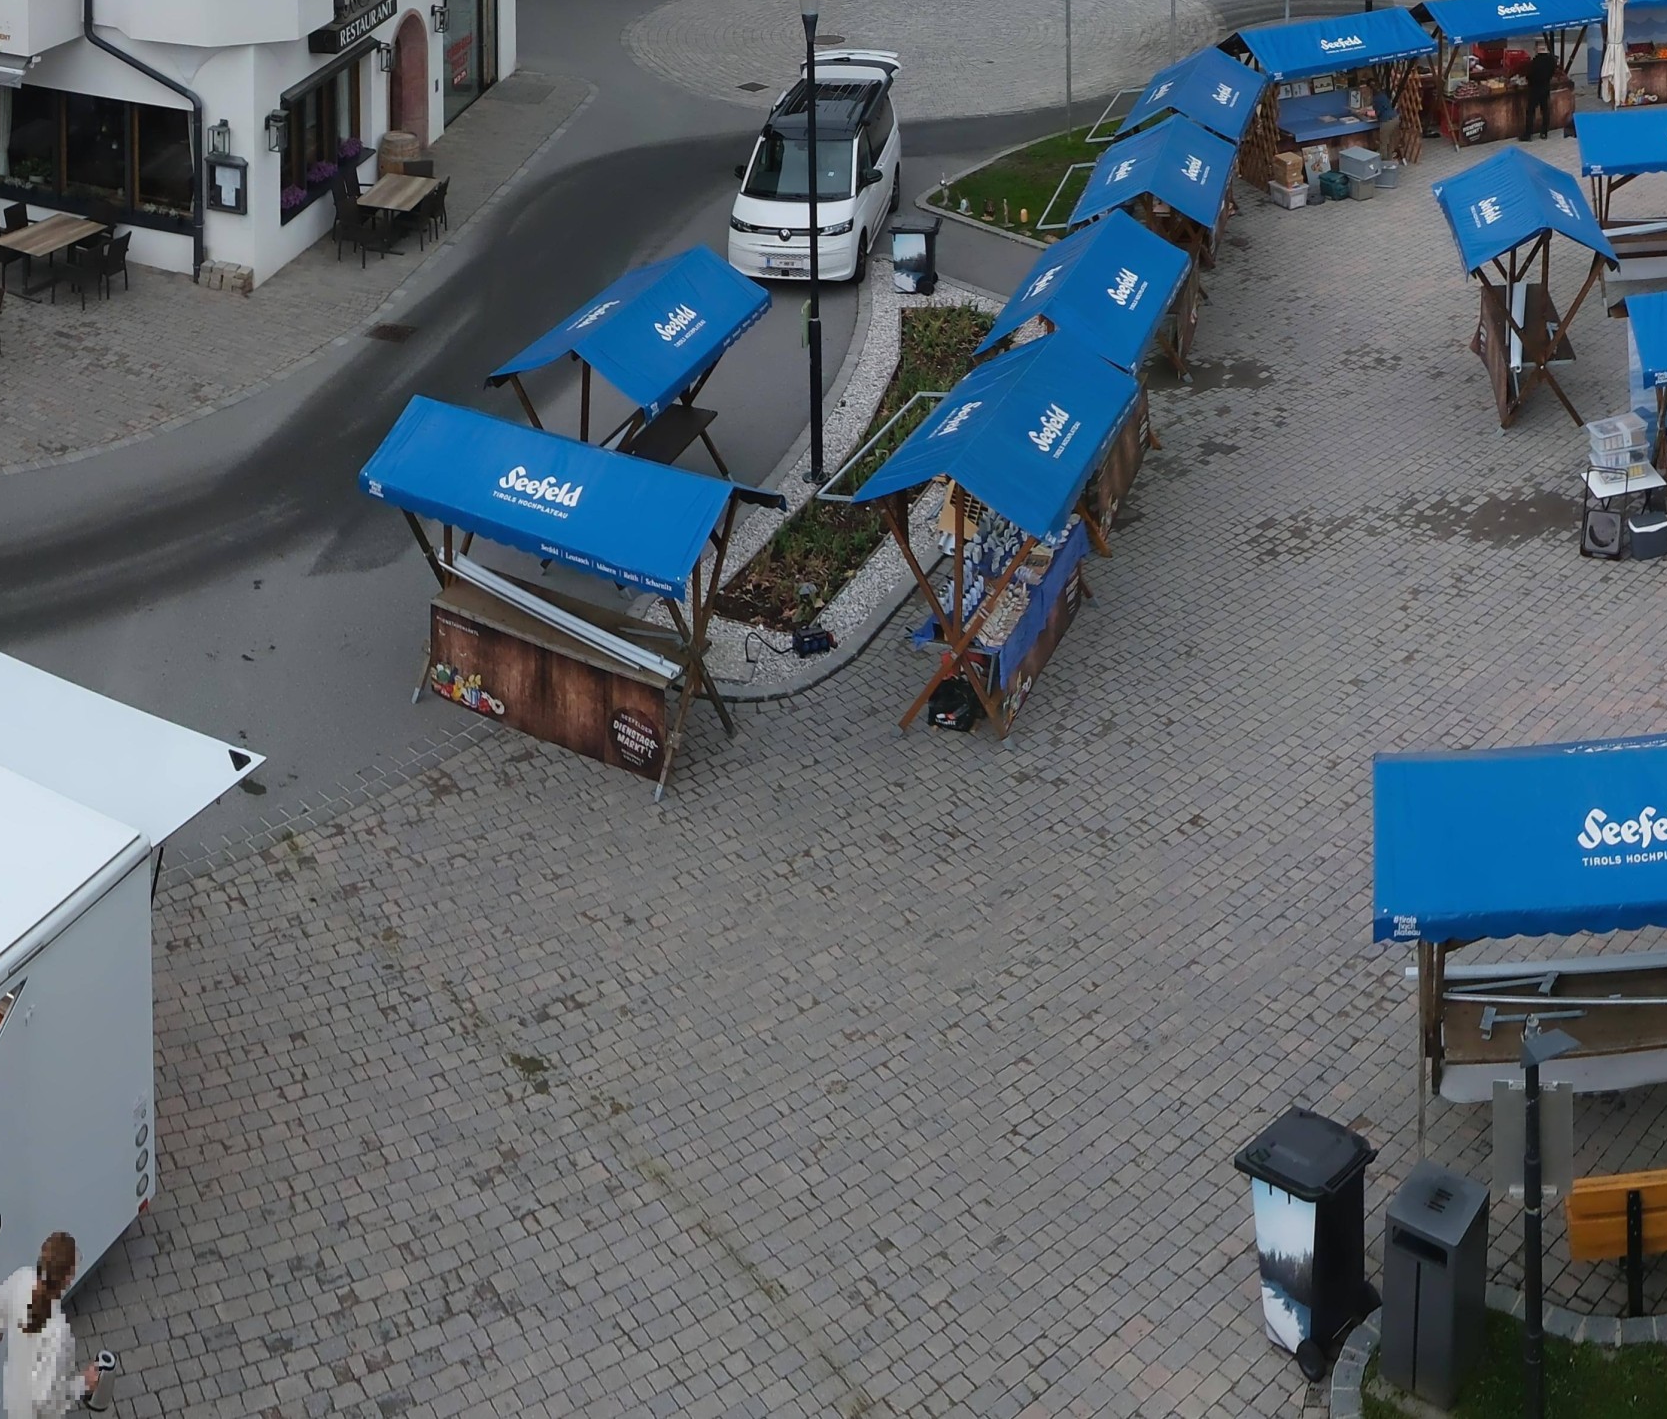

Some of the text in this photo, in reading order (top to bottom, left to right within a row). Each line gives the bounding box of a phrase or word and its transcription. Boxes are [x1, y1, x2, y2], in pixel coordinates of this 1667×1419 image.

[654, 303, 698, 342] Seefeld
[1027, 403, 1070, 451] Seefeld
[492, 490, 569, 519] TIROLS HOCHPLATEAU
[498, 465, 583, 507] Seefeld
[1582, 855, 1623, 867] TIROLS
